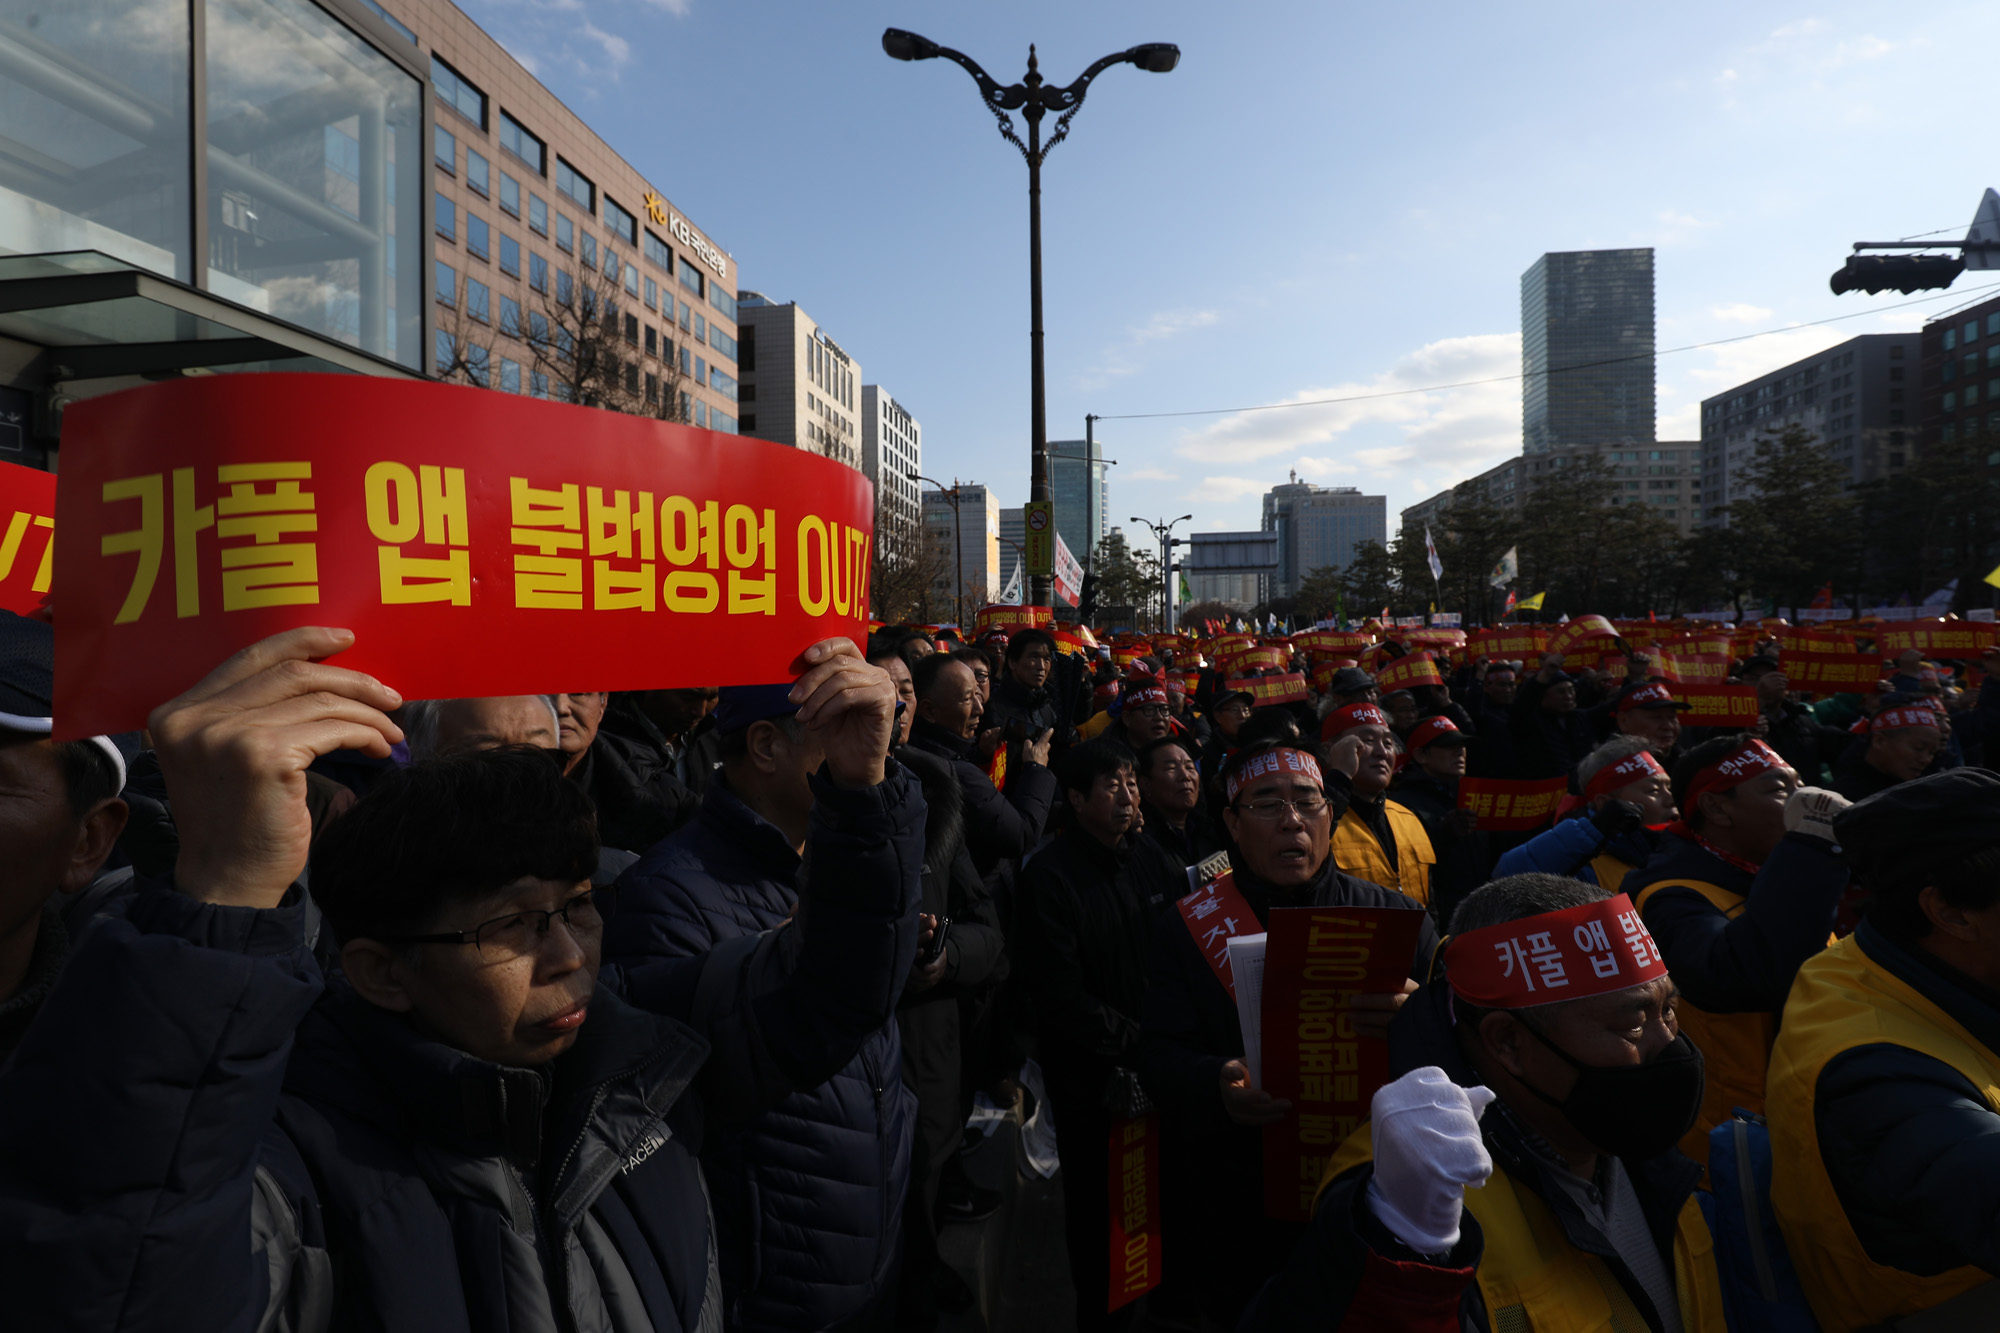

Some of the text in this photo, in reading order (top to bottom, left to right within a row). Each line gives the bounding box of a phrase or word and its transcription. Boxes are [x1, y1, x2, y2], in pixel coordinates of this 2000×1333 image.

[669, 211, 726, 278] KB국민은행
[101, 460, 870, 626] 카풀 앱 불법영업 OUT!
[1285, 680, 1305, 695] OUT!
[1687, 696, 1728, 715] 불법영업
[1731, 696, 1758, 716] OUT!
[1717, 749, 1771, 777] 택시를
[1464, 792, 1494, 817] 카풀
[1494, 793, 1512, 817] 앱
[1302, 915, 1378, 982] OUT!
[1494, 930, 1570, 993] 카풀
[1573, 919, 1620, 979] 앱
[1298, 988, 1364, 1103] 불법영업
[1299, 1112, 1359, 1146] 앱
[1122, 1145, 1148, 1236] 불법영업
[1123, 1231, 1149, 1294] OUT!
